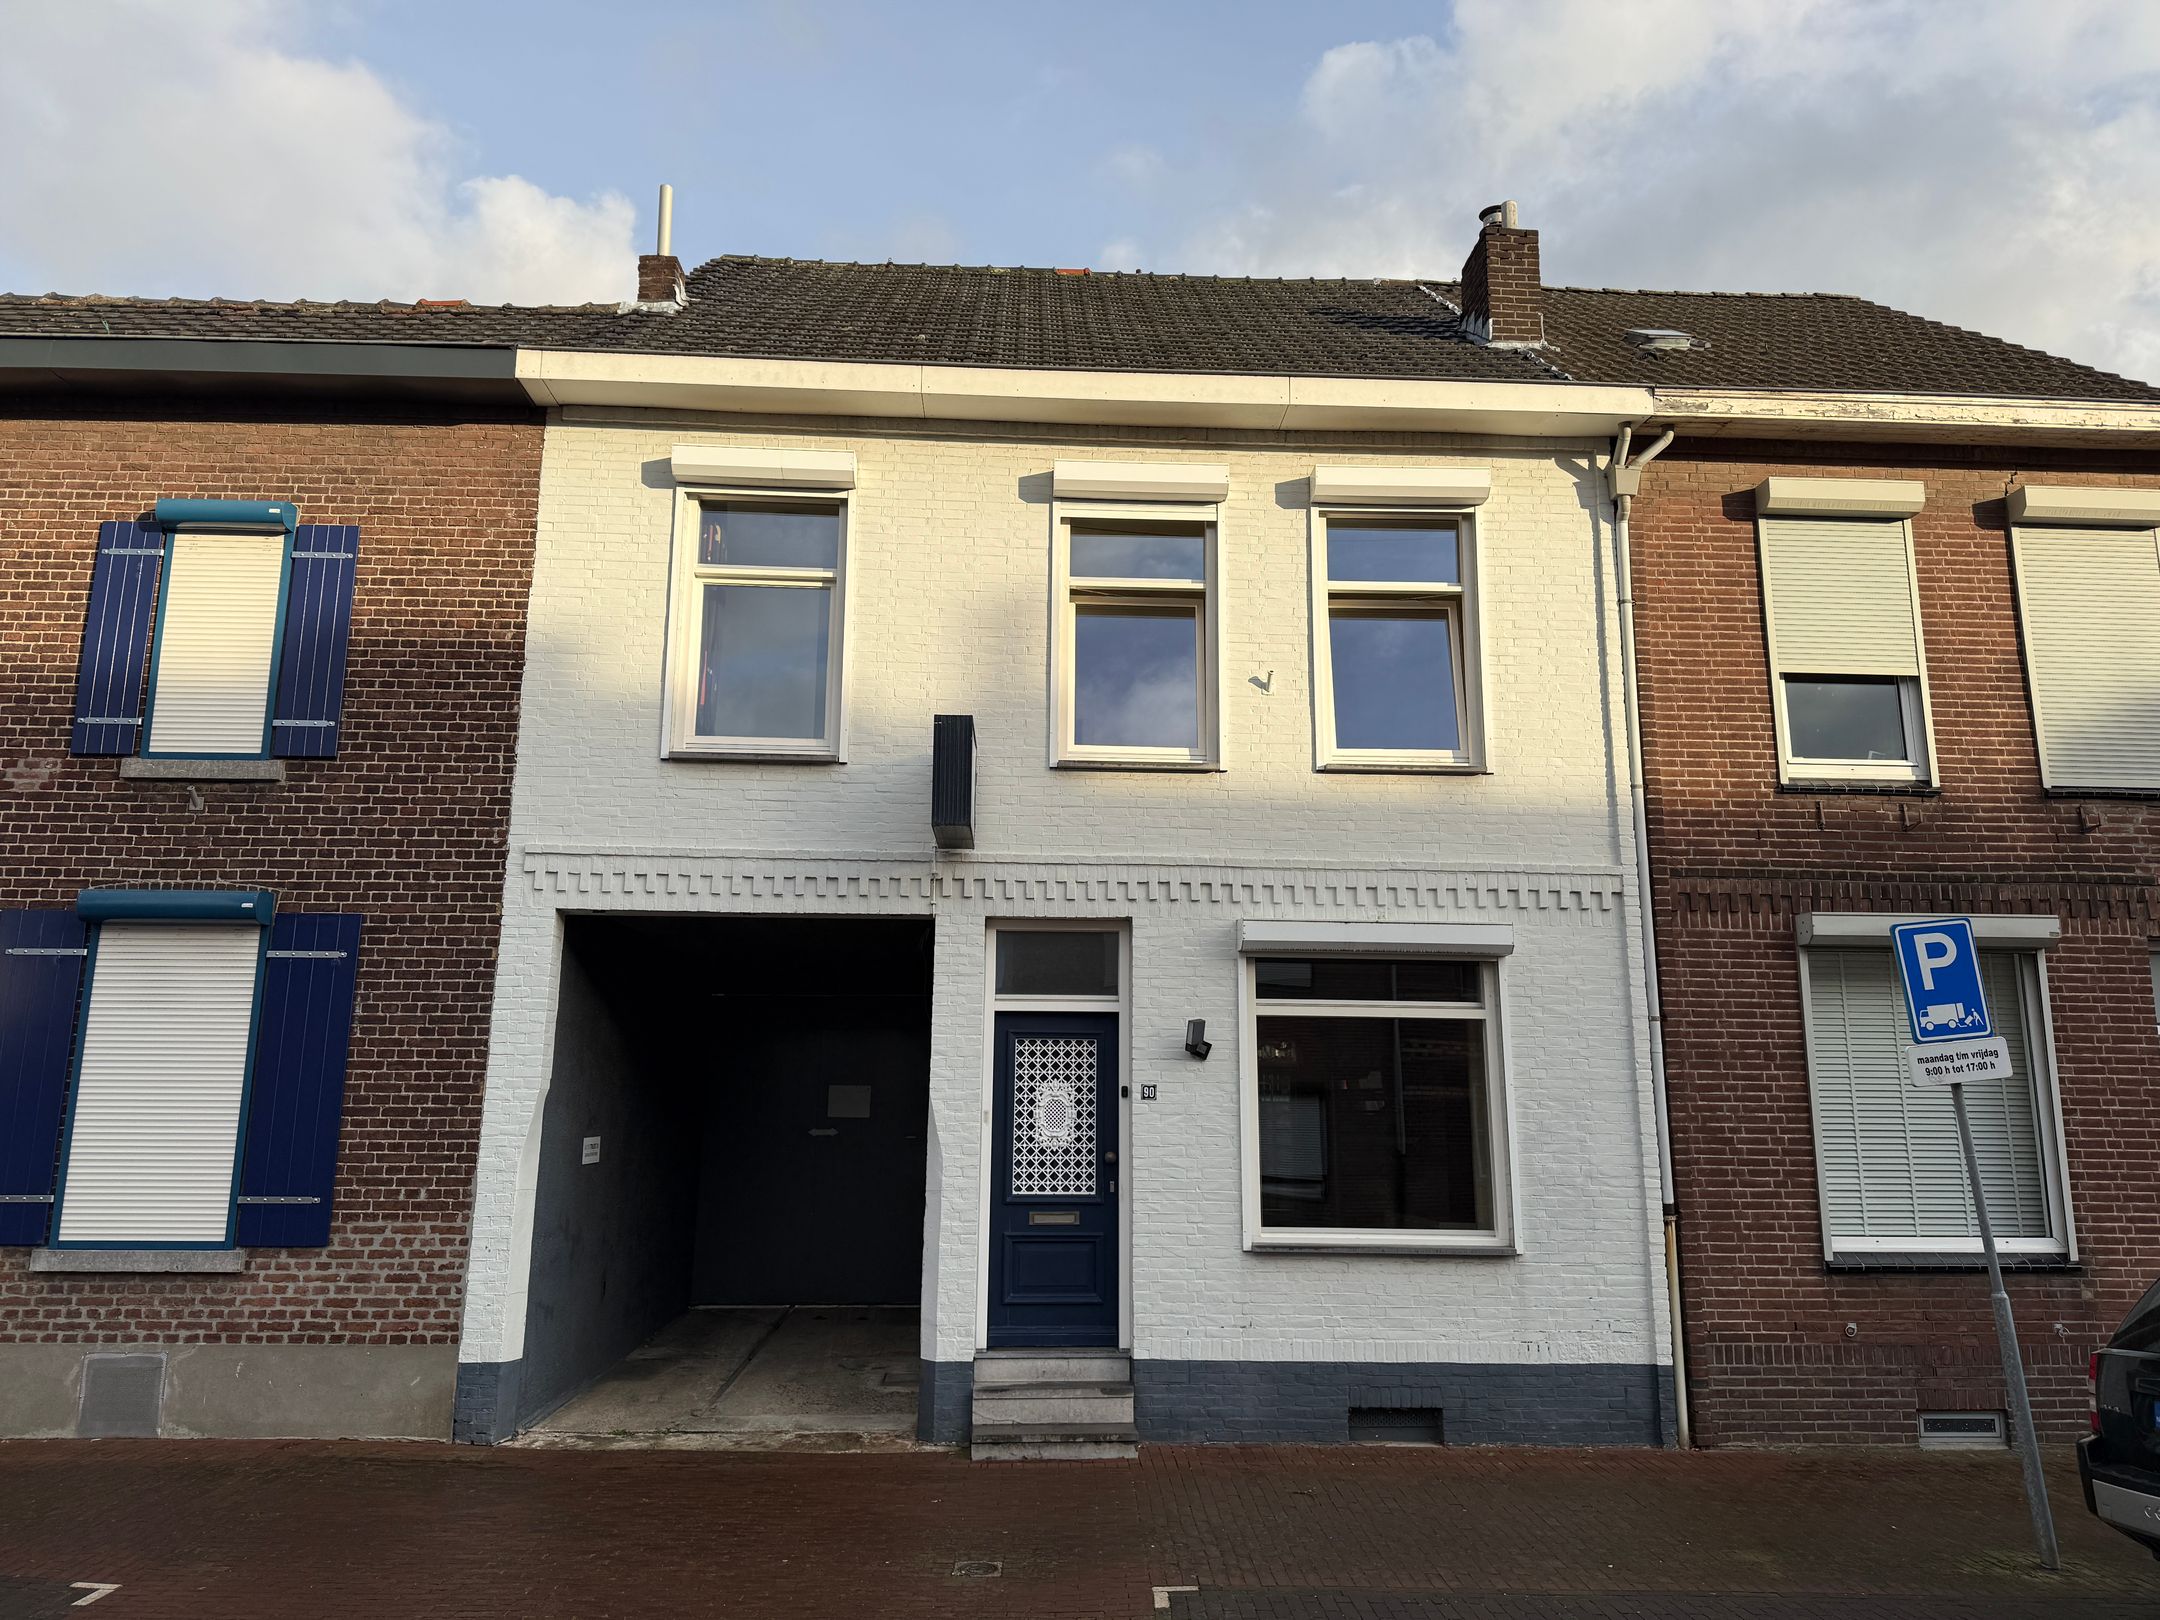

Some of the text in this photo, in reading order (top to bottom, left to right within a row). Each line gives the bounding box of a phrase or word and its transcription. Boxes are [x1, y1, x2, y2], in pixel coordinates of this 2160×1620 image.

[1913, 932, 1957, 991] P
[1917, 1049, 1999, 1065] maandag t/m vrijdag
[1925, 1061, 1996, 1076] 9:00 h tot 17:00 h
[1143, 1086, 1155, 1098] 90
